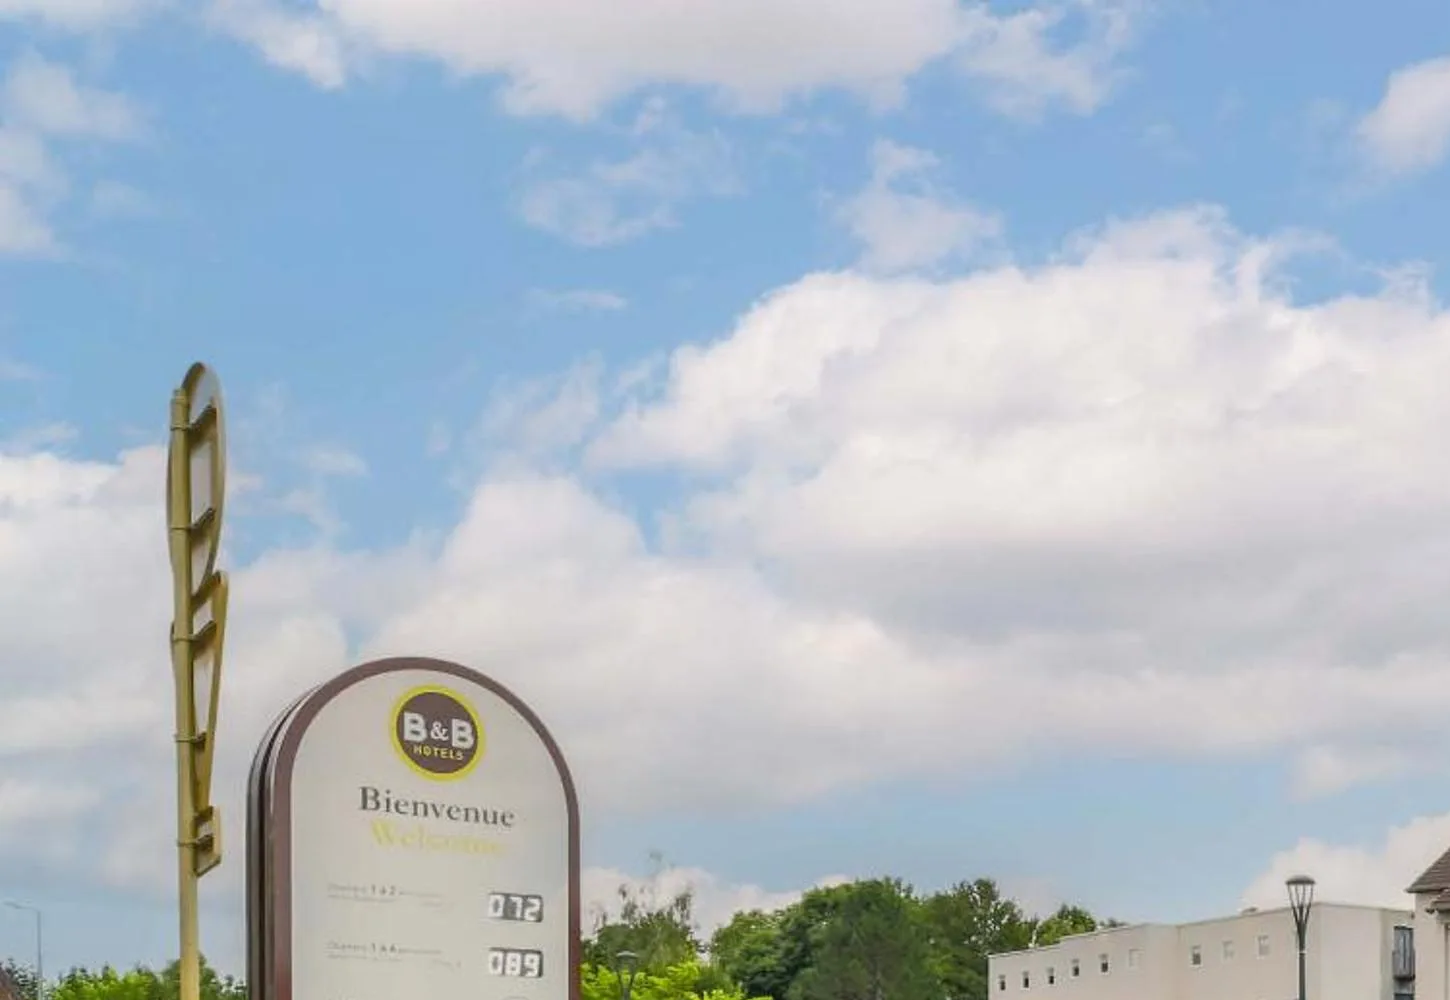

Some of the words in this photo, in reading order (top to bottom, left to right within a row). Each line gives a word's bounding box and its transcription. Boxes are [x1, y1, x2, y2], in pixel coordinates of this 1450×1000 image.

[402, 711, 476, 750] B&B
[413, 743, 465, 761] HOTELS
[358, 785, 517, 829] Bienvenue
